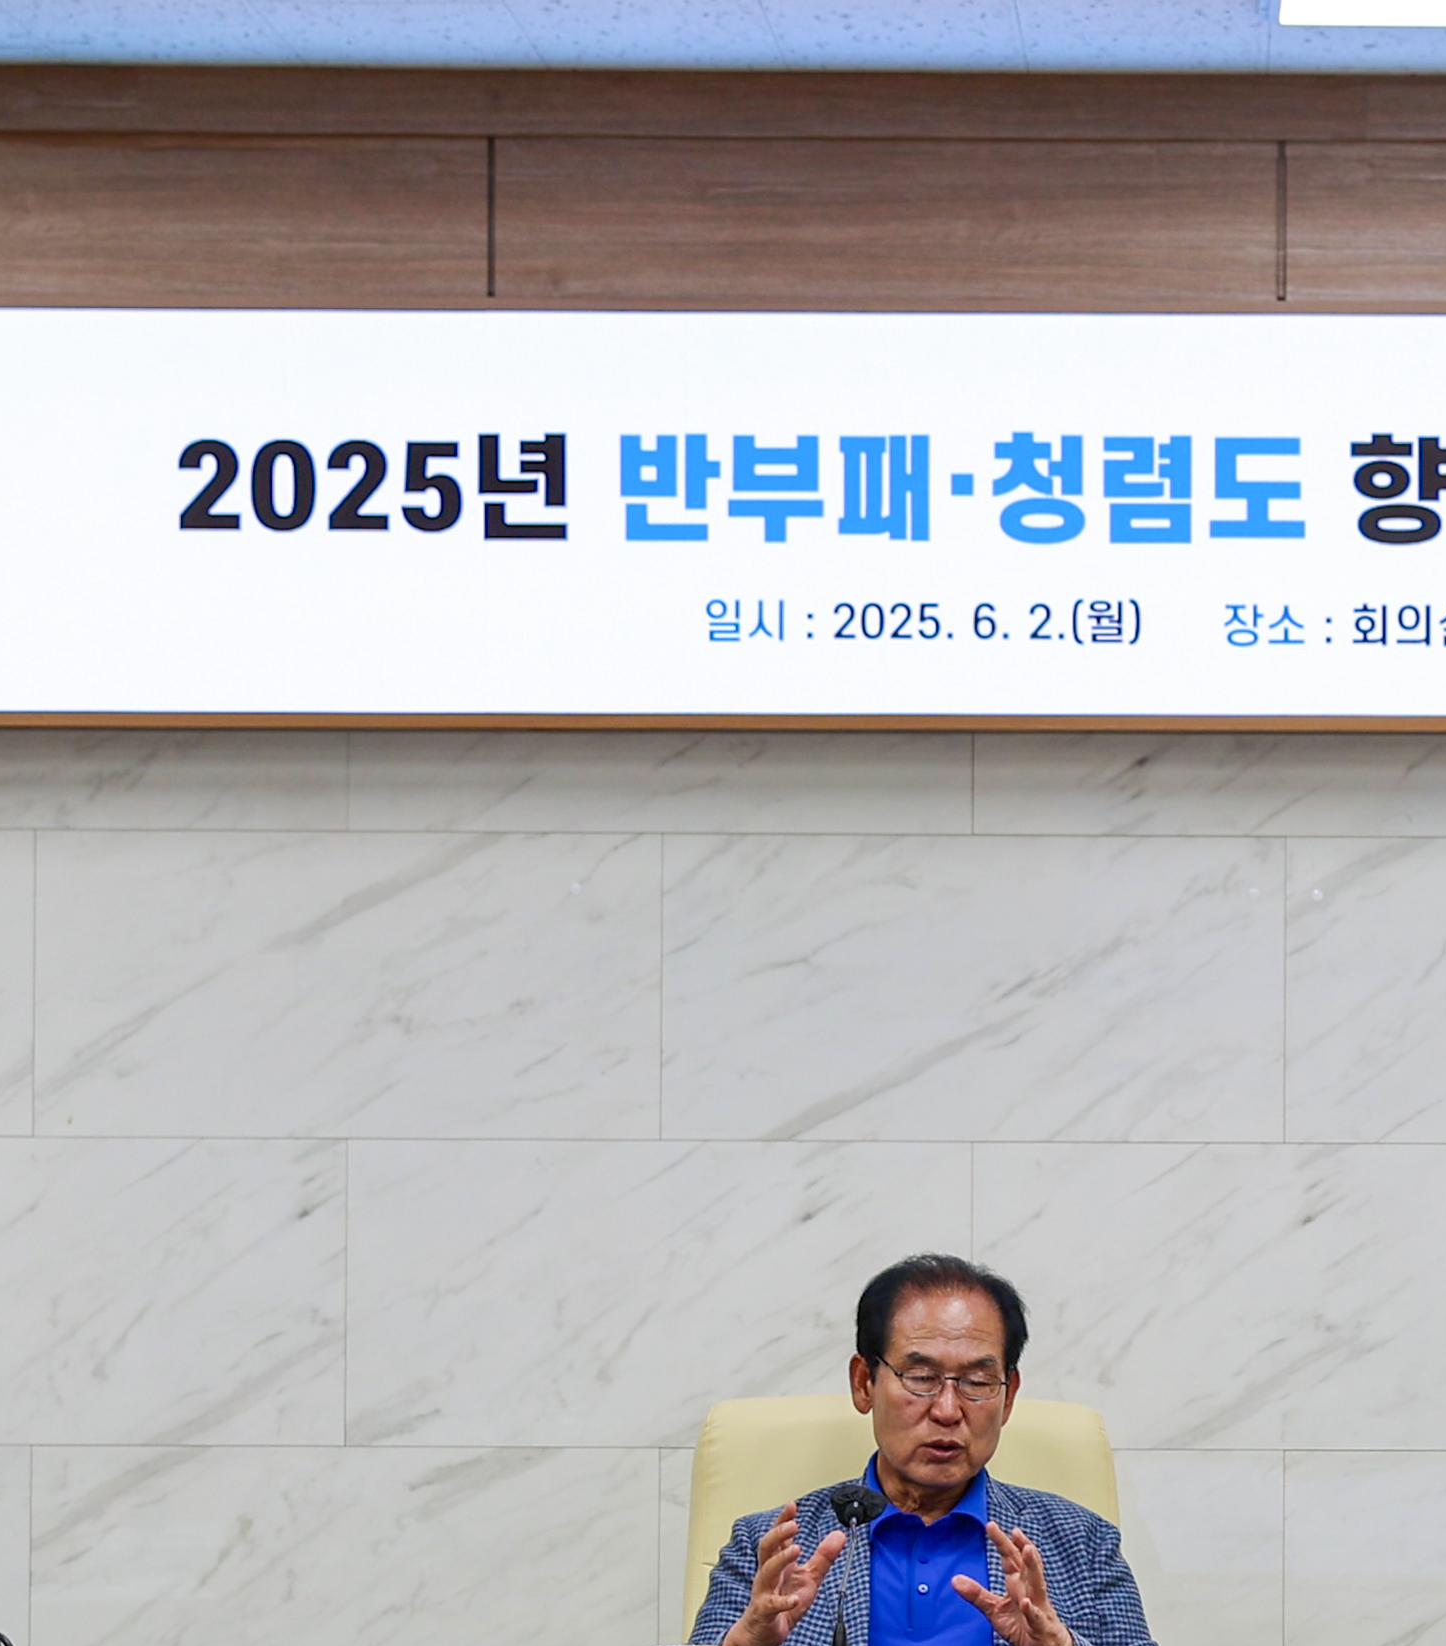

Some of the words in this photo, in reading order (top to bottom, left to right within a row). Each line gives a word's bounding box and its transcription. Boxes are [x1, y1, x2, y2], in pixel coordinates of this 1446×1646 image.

[178, 431, 569, 542] 2025년
[620, 431, 1307, 546] 반부패·청렴도
[705, 598, 785, 643] 일시
[833, 601, 954, 641] 2025.
[973, 601, 1010, 641] 6.
[1029, 598, 1142, 645] 2.(월)
[1223, 603, 1306, 648] 장소
